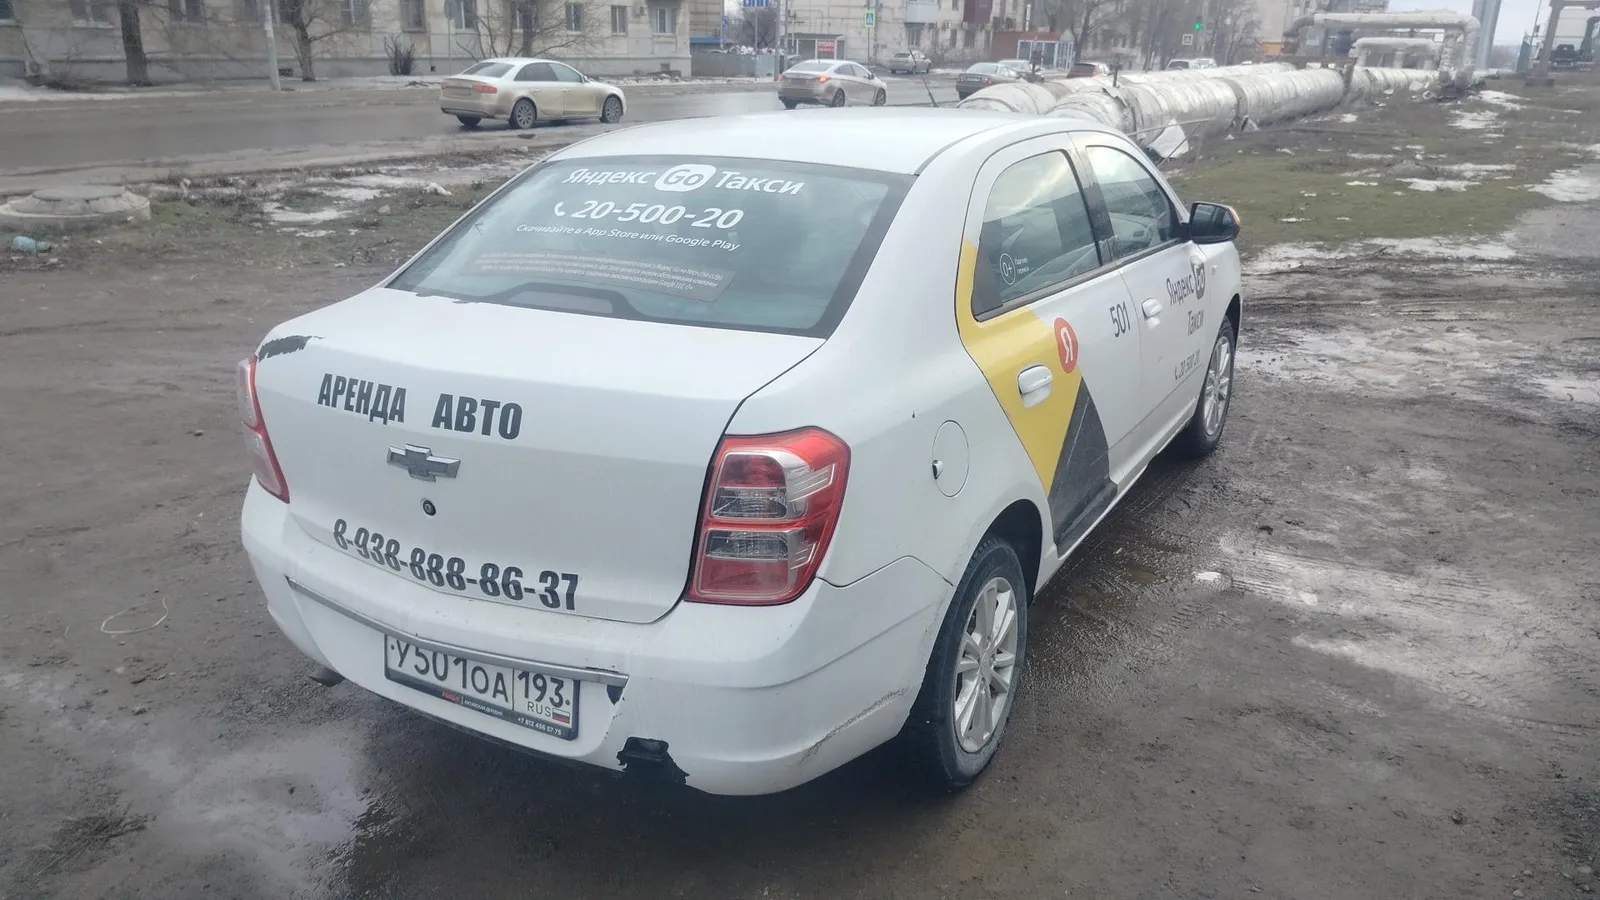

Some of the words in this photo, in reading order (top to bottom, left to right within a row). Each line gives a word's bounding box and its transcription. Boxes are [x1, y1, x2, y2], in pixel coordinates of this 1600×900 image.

[563, 168, 656, 185] Яндекс
[669, 169, 704, 186] Go
[715, 171, 805, 195] Такси
[571, 200, 744, 229] 20-500-20
[516, 224, 574, 234] Скачивайте
[583, 228, 607, 237] App
[607, 229, 638, 239] Store
[639, 233, 663, 241] или
[665, 235, 709, 247] Google
[711, 239, 740, 251] Play
[1003, 262, 1012, 276] 0+
[1166, 274, 1194, 306] Яндекс
[1110, 301, 1130, 337] 501
[1188, 310, 1204, 336] Такси
[1061, 327, 1073, 363] Я
[317, 373, 407, 425] АРЕНДА
[431, 393, 523, 440] АВТО
[333, 518, 579, 610] 8-938-888-86-37
[517, 671, 564, 708] 193
[527, 701, 552, 717] RUS
